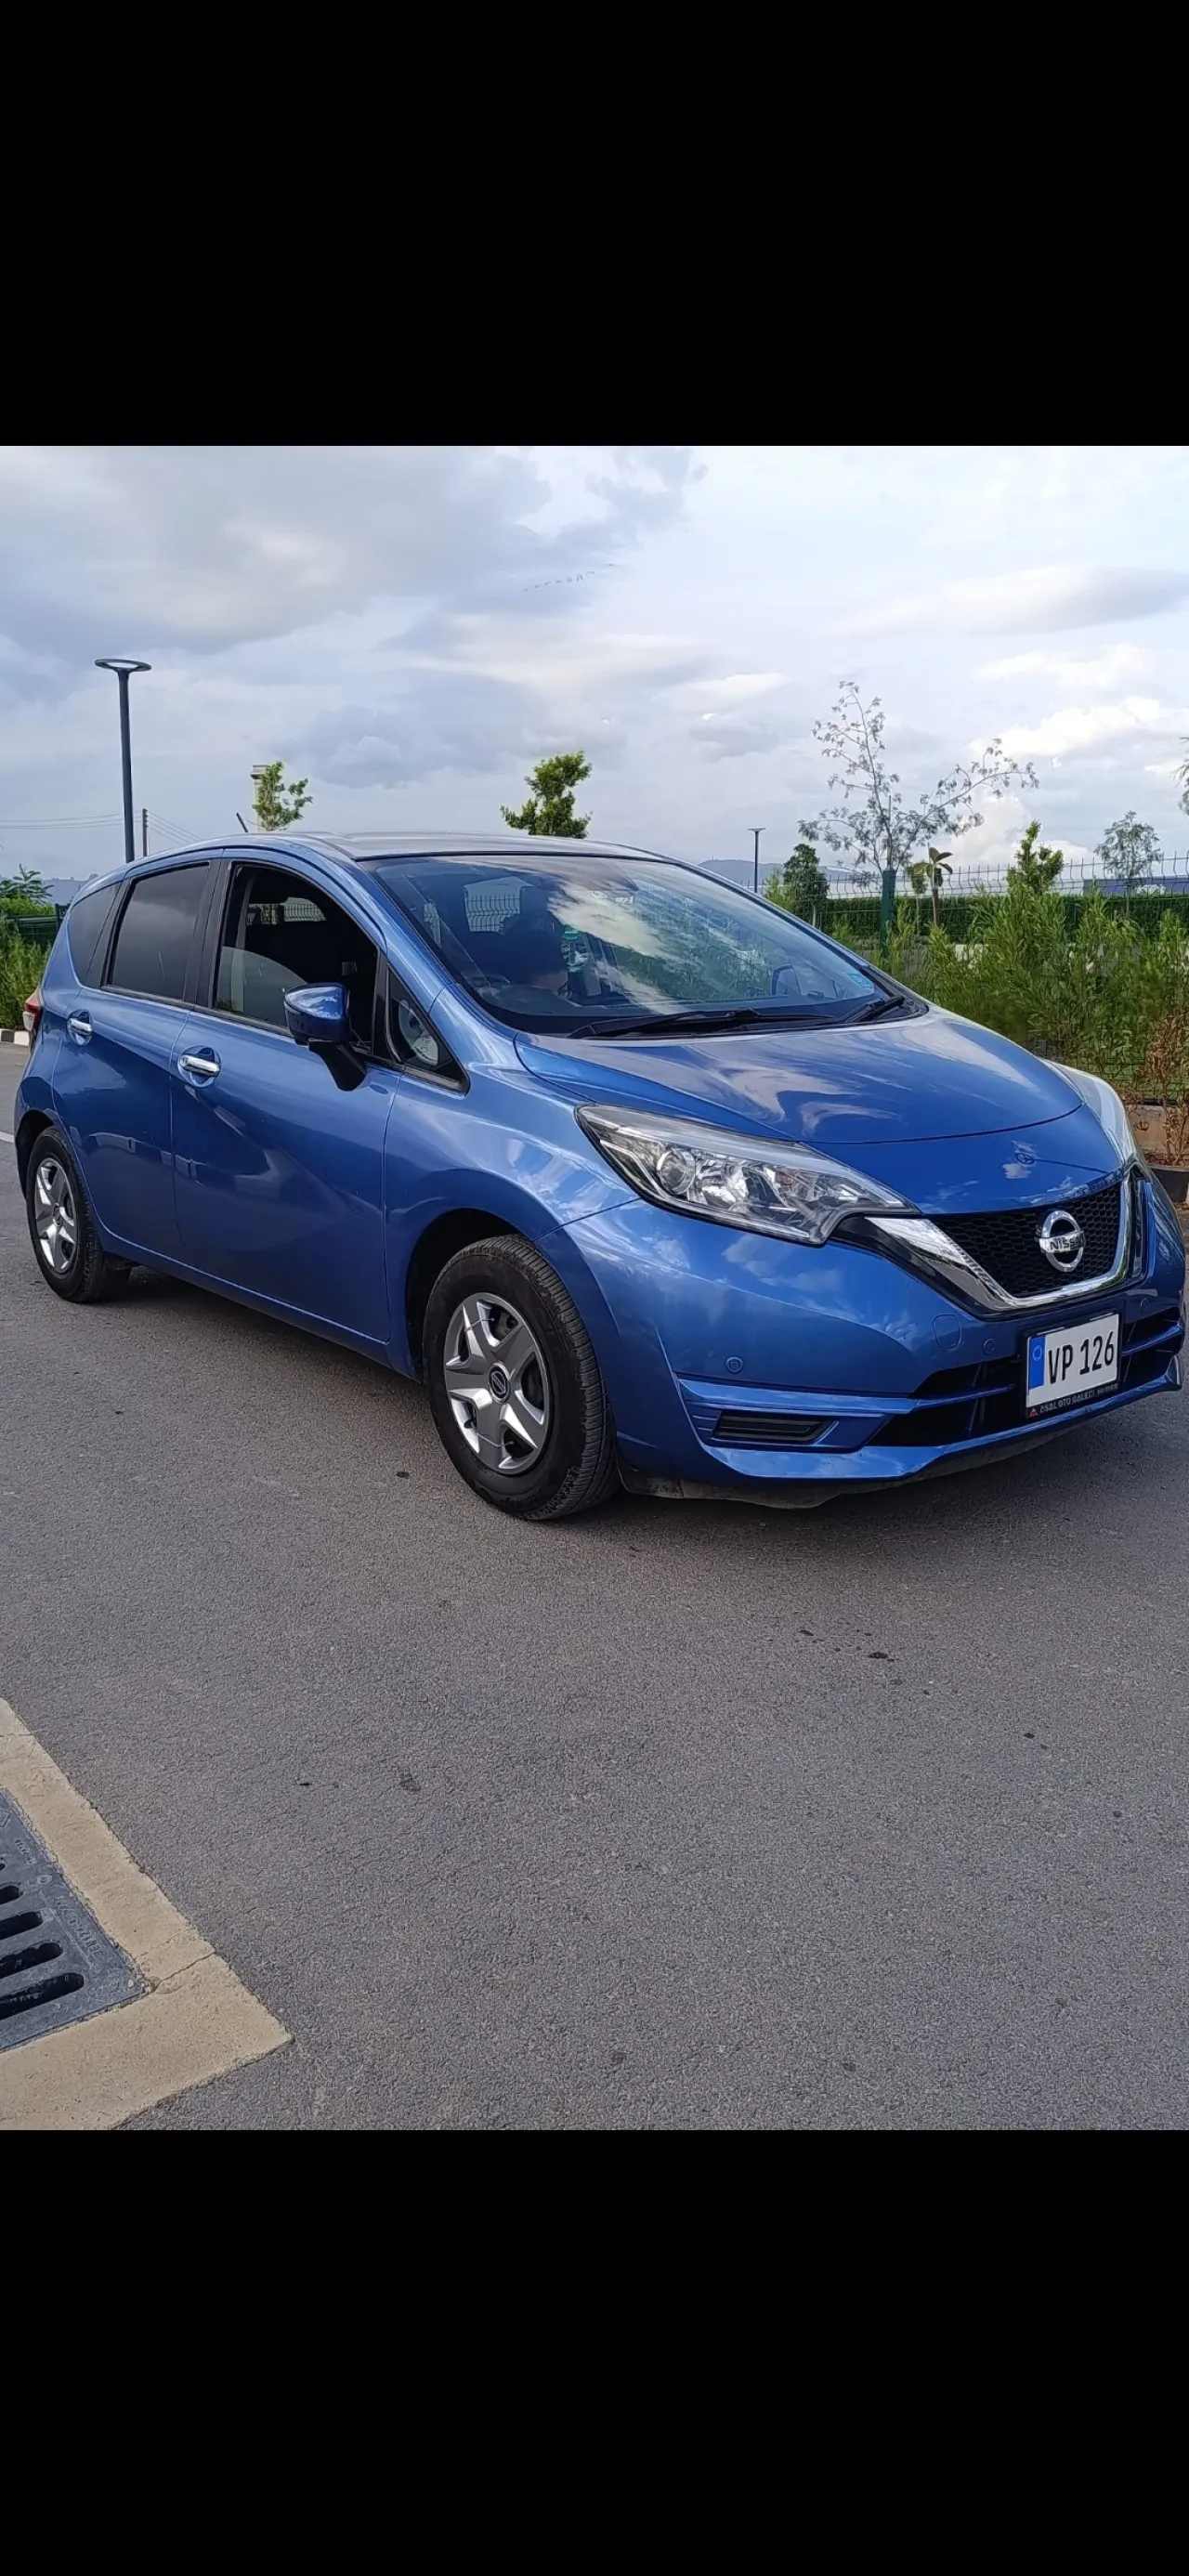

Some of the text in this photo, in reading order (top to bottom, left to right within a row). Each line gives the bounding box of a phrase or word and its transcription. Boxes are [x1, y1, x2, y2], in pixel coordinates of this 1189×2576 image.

[1048, 1331, 1115, 1384] VP 126
[1058, 1397, 1071, 1407] OTO
